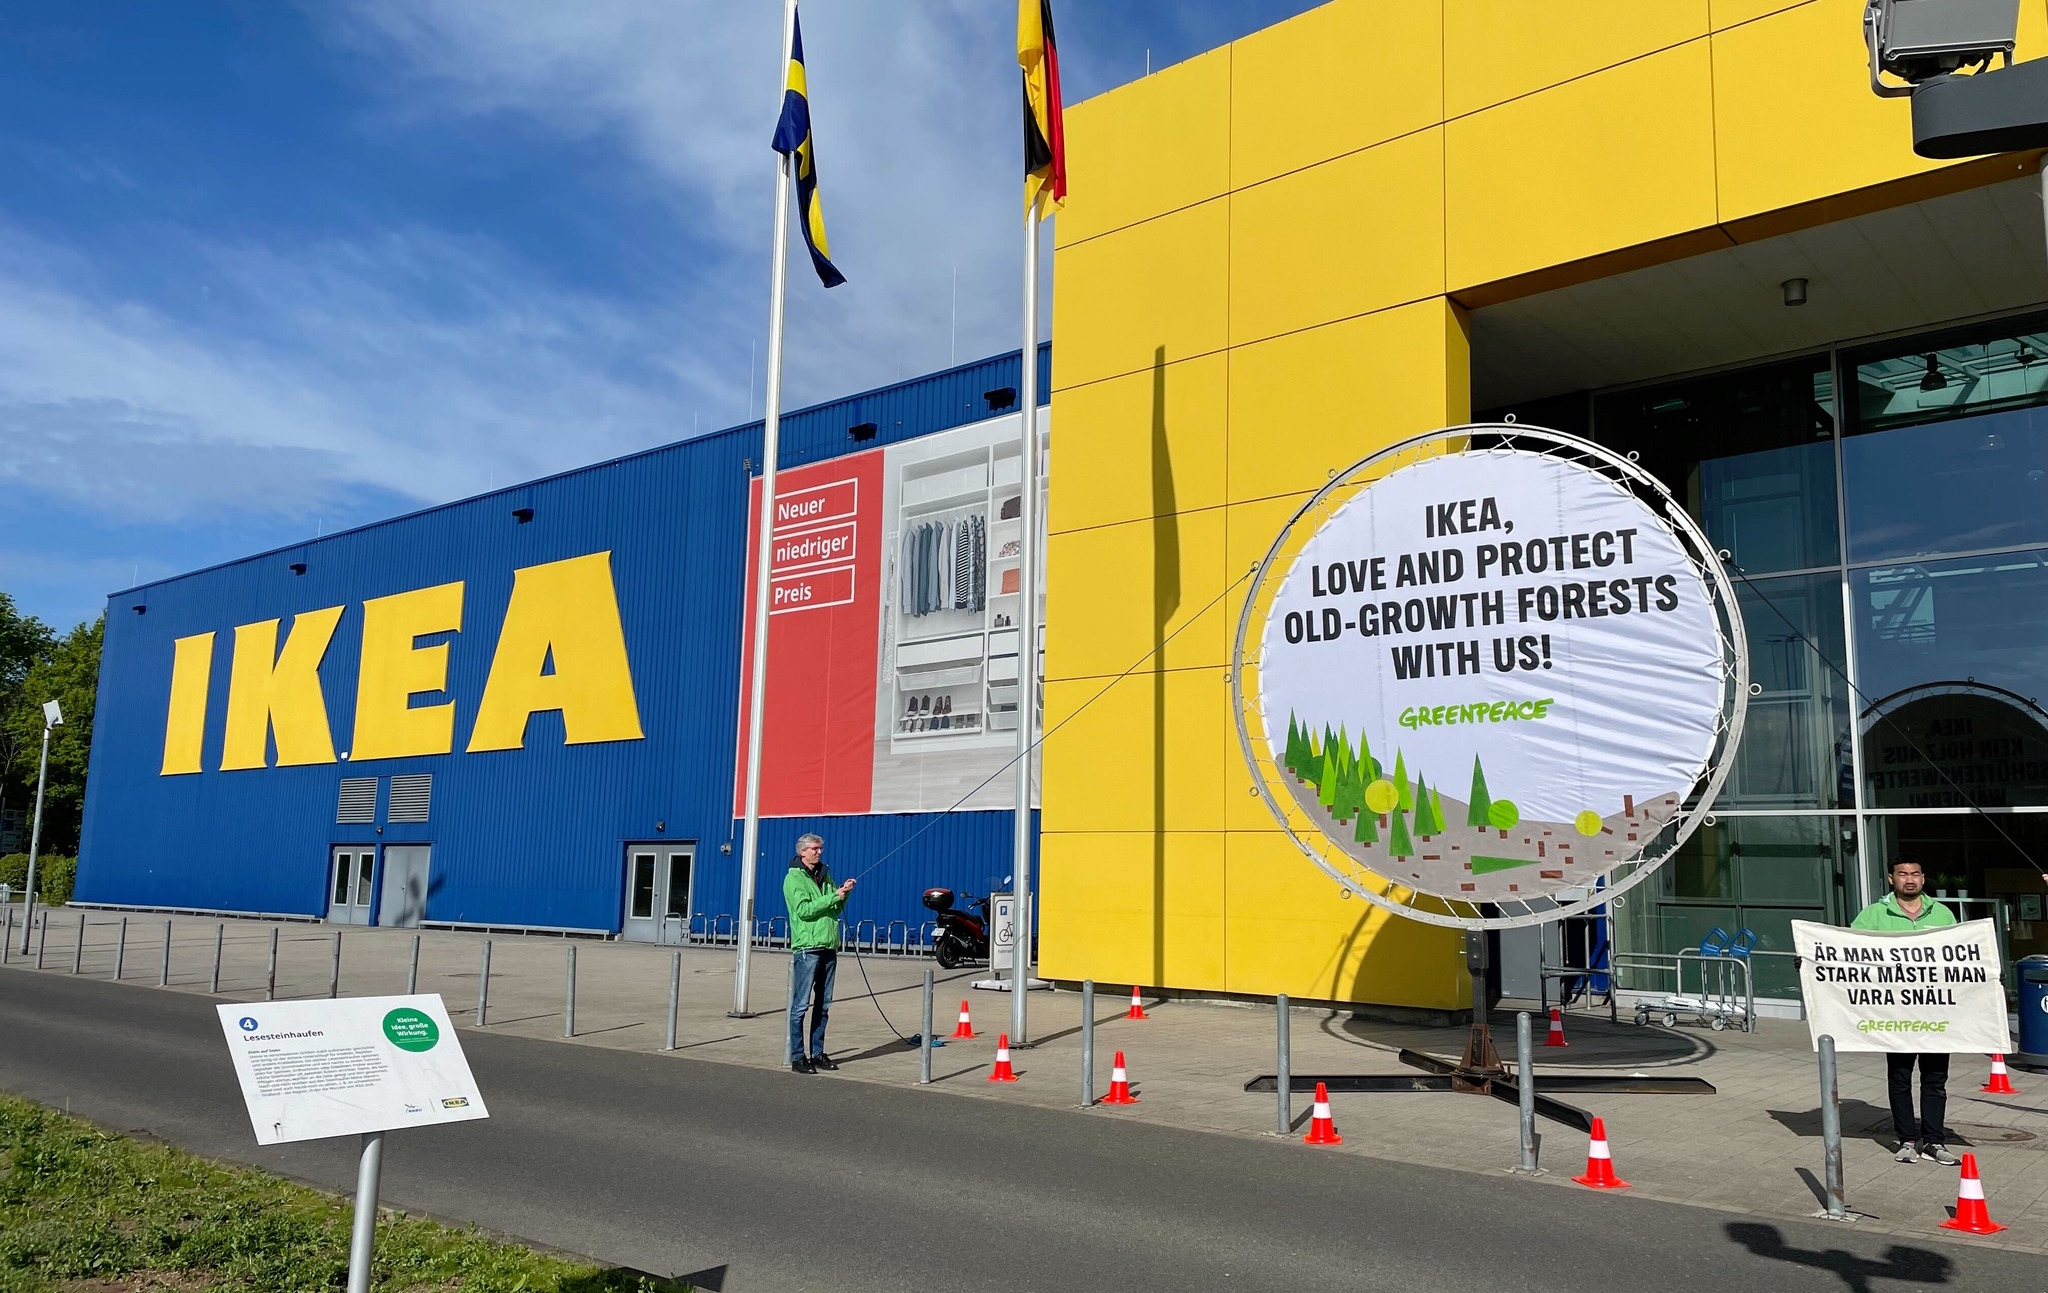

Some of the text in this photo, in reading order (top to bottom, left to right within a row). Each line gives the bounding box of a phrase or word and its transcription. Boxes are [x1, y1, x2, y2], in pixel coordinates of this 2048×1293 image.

[778, 498, 826, 521] Neuer
[1425, 497, 1514, 538] IKEA,
[776, 535, 848, 561] niedriger
[1311, 528, 1638, 597] LOVE AND PROTECT
[774, 582, 812, 605] Preis
[1284, 574, 1679, 644] OLD-GROWTH FORESTS
[159, 550, 646, 777] IKEA
[1391, 634, 1554, 680] WITH US!
[1398, 697, 1555, 731] GREENPEACE
[1814, 941, 1981, 963] ÄR MAN STOR OCH
[1815, 963, 1987, 983] STARK MÅSTE MAN
[1847, 987, 1957, 1006] VARA SNÄLL
[243, 1018, 255, 1030] 4
[1856, 1019, 1950, 1033] GREENPEACE
[243, 1030, 324, 1042] Lesesteinhaufen
